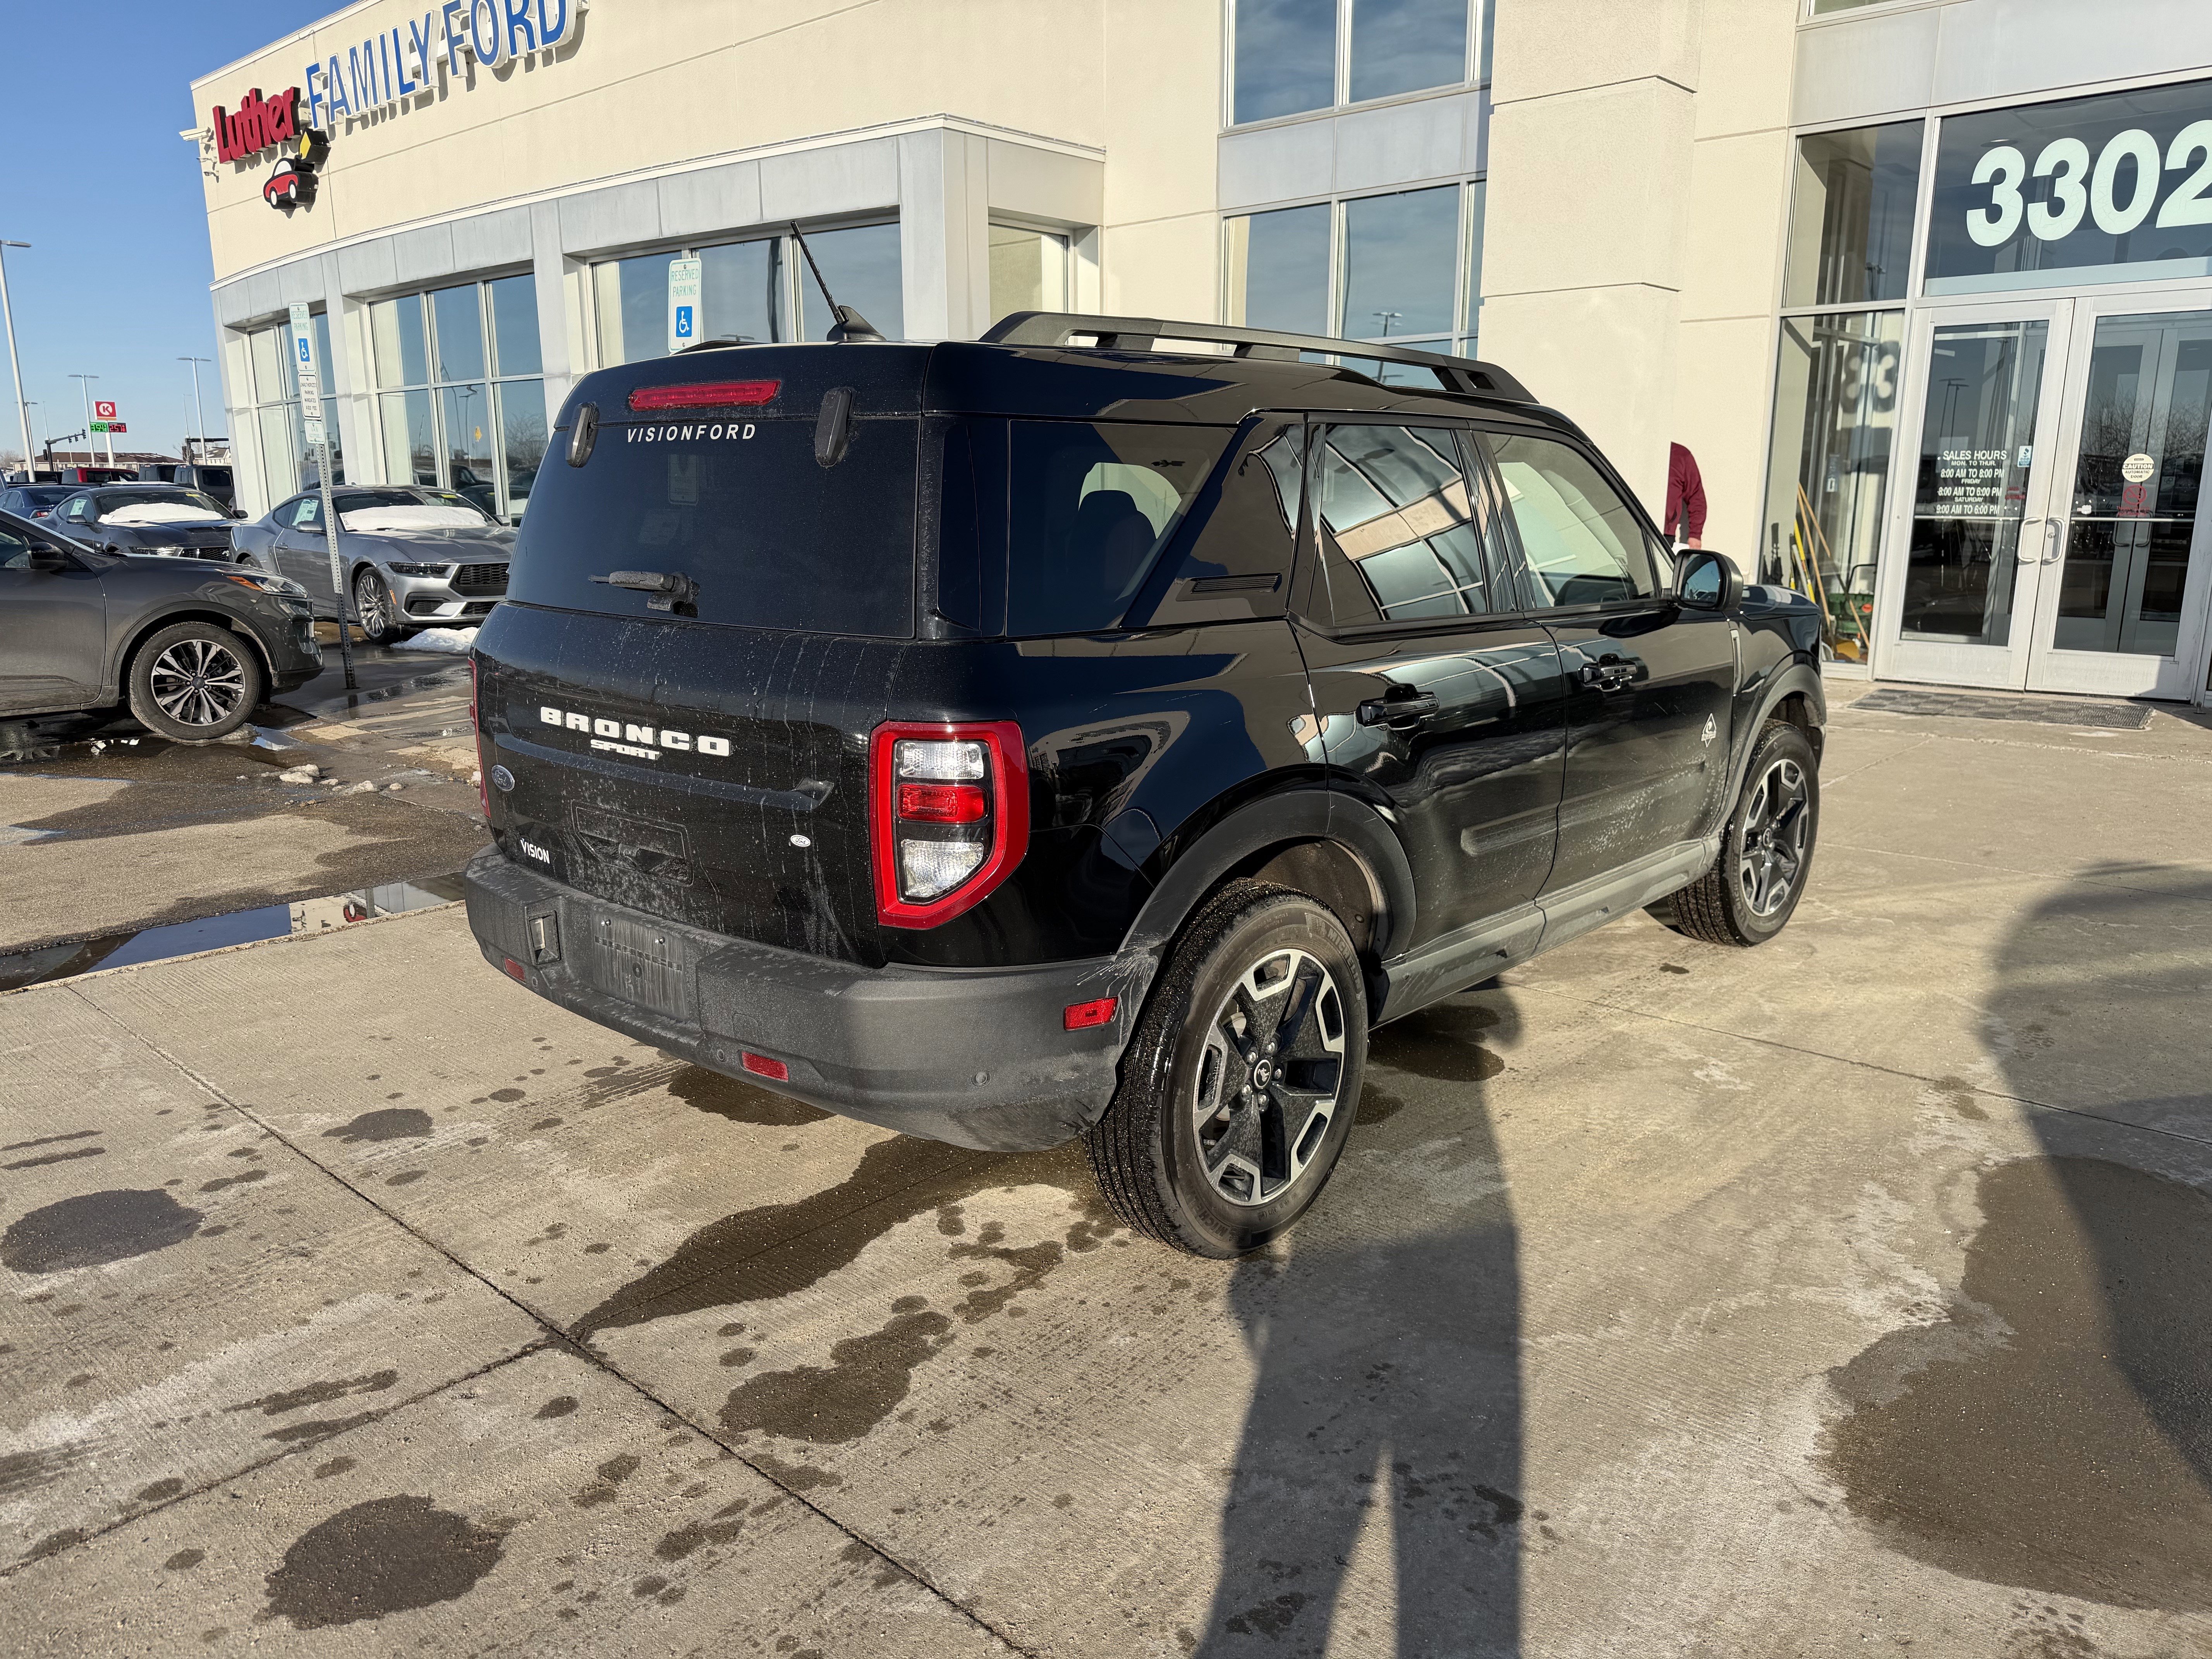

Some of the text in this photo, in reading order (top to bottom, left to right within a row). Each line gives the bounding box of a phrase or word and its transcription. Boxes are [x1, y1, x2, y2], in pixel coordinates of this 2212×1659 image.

[305, 0, 576, 131] FAMILY FORD
[213, 86, 301, 164] Luther
[1966, 119, 2212, 247] 3302
[671, 269, 699, 281] RESERVED
[673, 284, 696, 297] PARKING
[627, 424, 756, 443] VISIONFORD
[1943, 450, 2007, 460] SALES HOURS
[1941, 468, 2005, 478] 8:00 AM TO 8:00 PM
[1938, 486, 1952, 496] 8:00
[1953, 487, 1964, 496] AM
[1966, 487, 1975, 496] TO
[1977, 487, 1990, 496] 6:00
[1992, 487, 2002, 496] PM
[1936, 504, 2000, 515] 9:00 AM TO 6:00 PM
[540, 706, 730, 756] BRONCO
[590, 739, 660, 760] SPORT
[520, 838, 550, 864] VISION
[595, 935, 682, 971] BRONCO
[1327, 927, 1363, 994] MICHELIN
